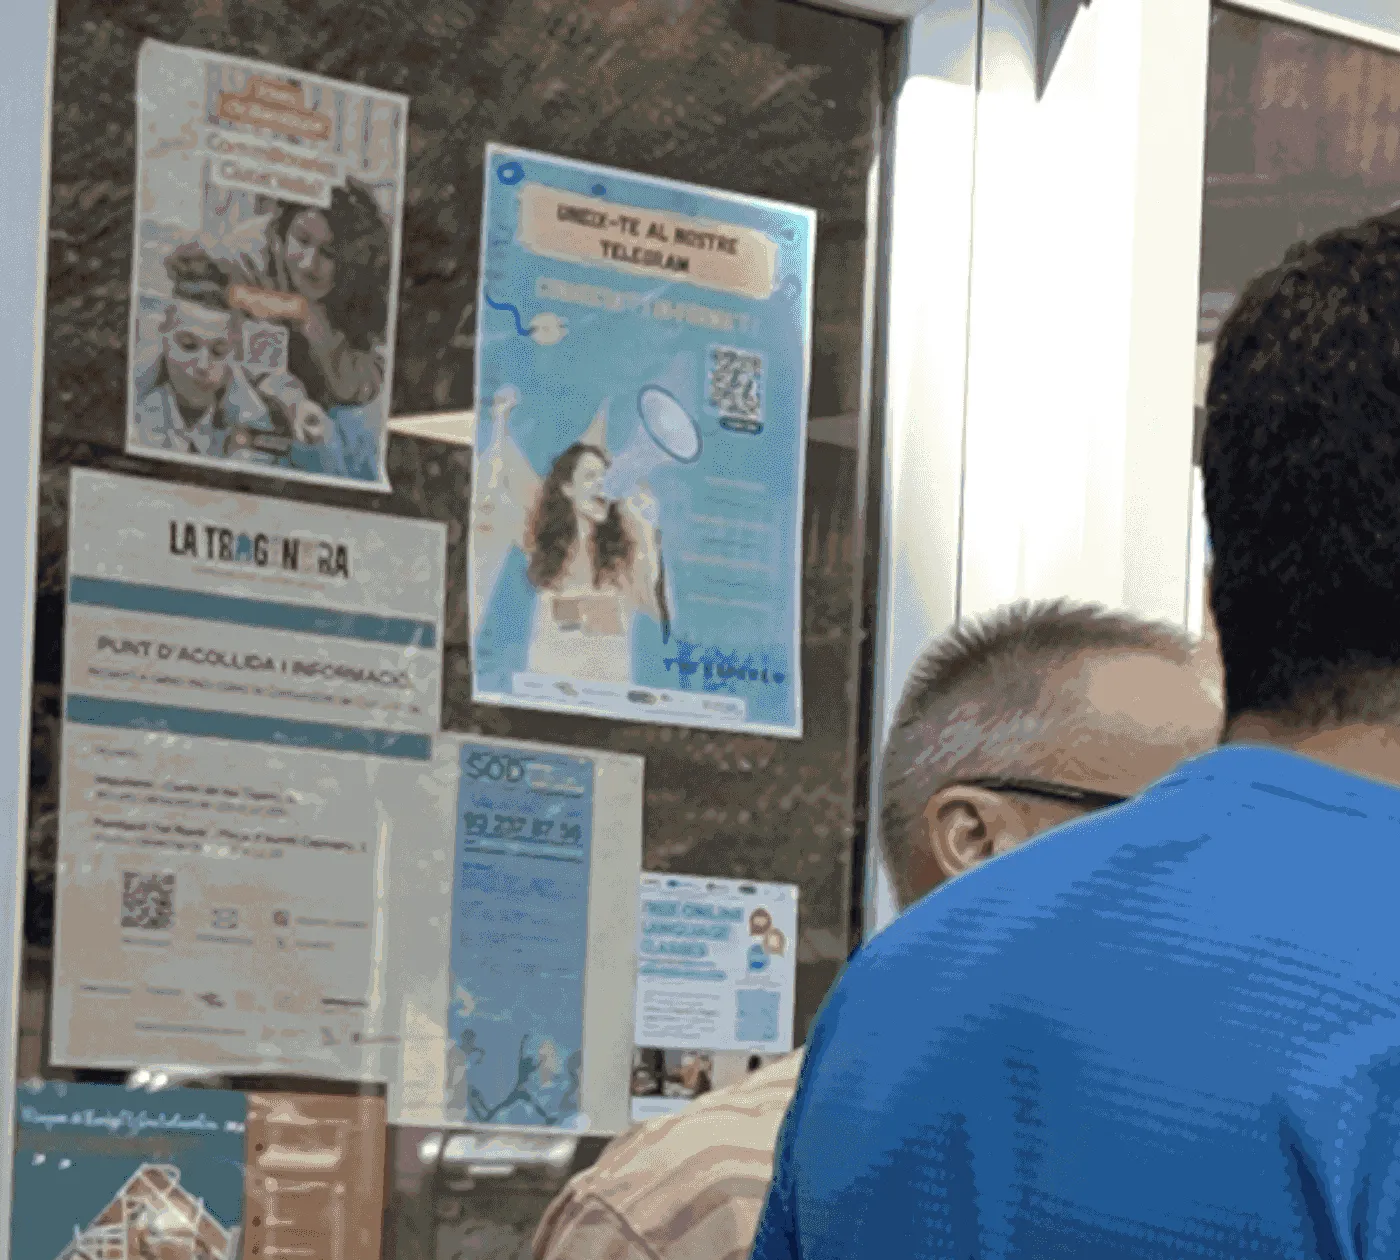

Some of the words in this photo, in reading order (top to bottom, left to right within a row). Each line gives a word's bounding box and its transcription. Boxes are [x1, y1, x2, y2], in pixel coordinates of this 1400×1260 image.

[646, 222, 668, 243] AL
[674, 228, 738, 254] NOSTRE
[600, 239, 690, 272] TELEGRAM
[169, 519, 197, 557] LA
[205, 526, 348, 578] TRAGNRA
[98, 635, 151, 658] PUNT
